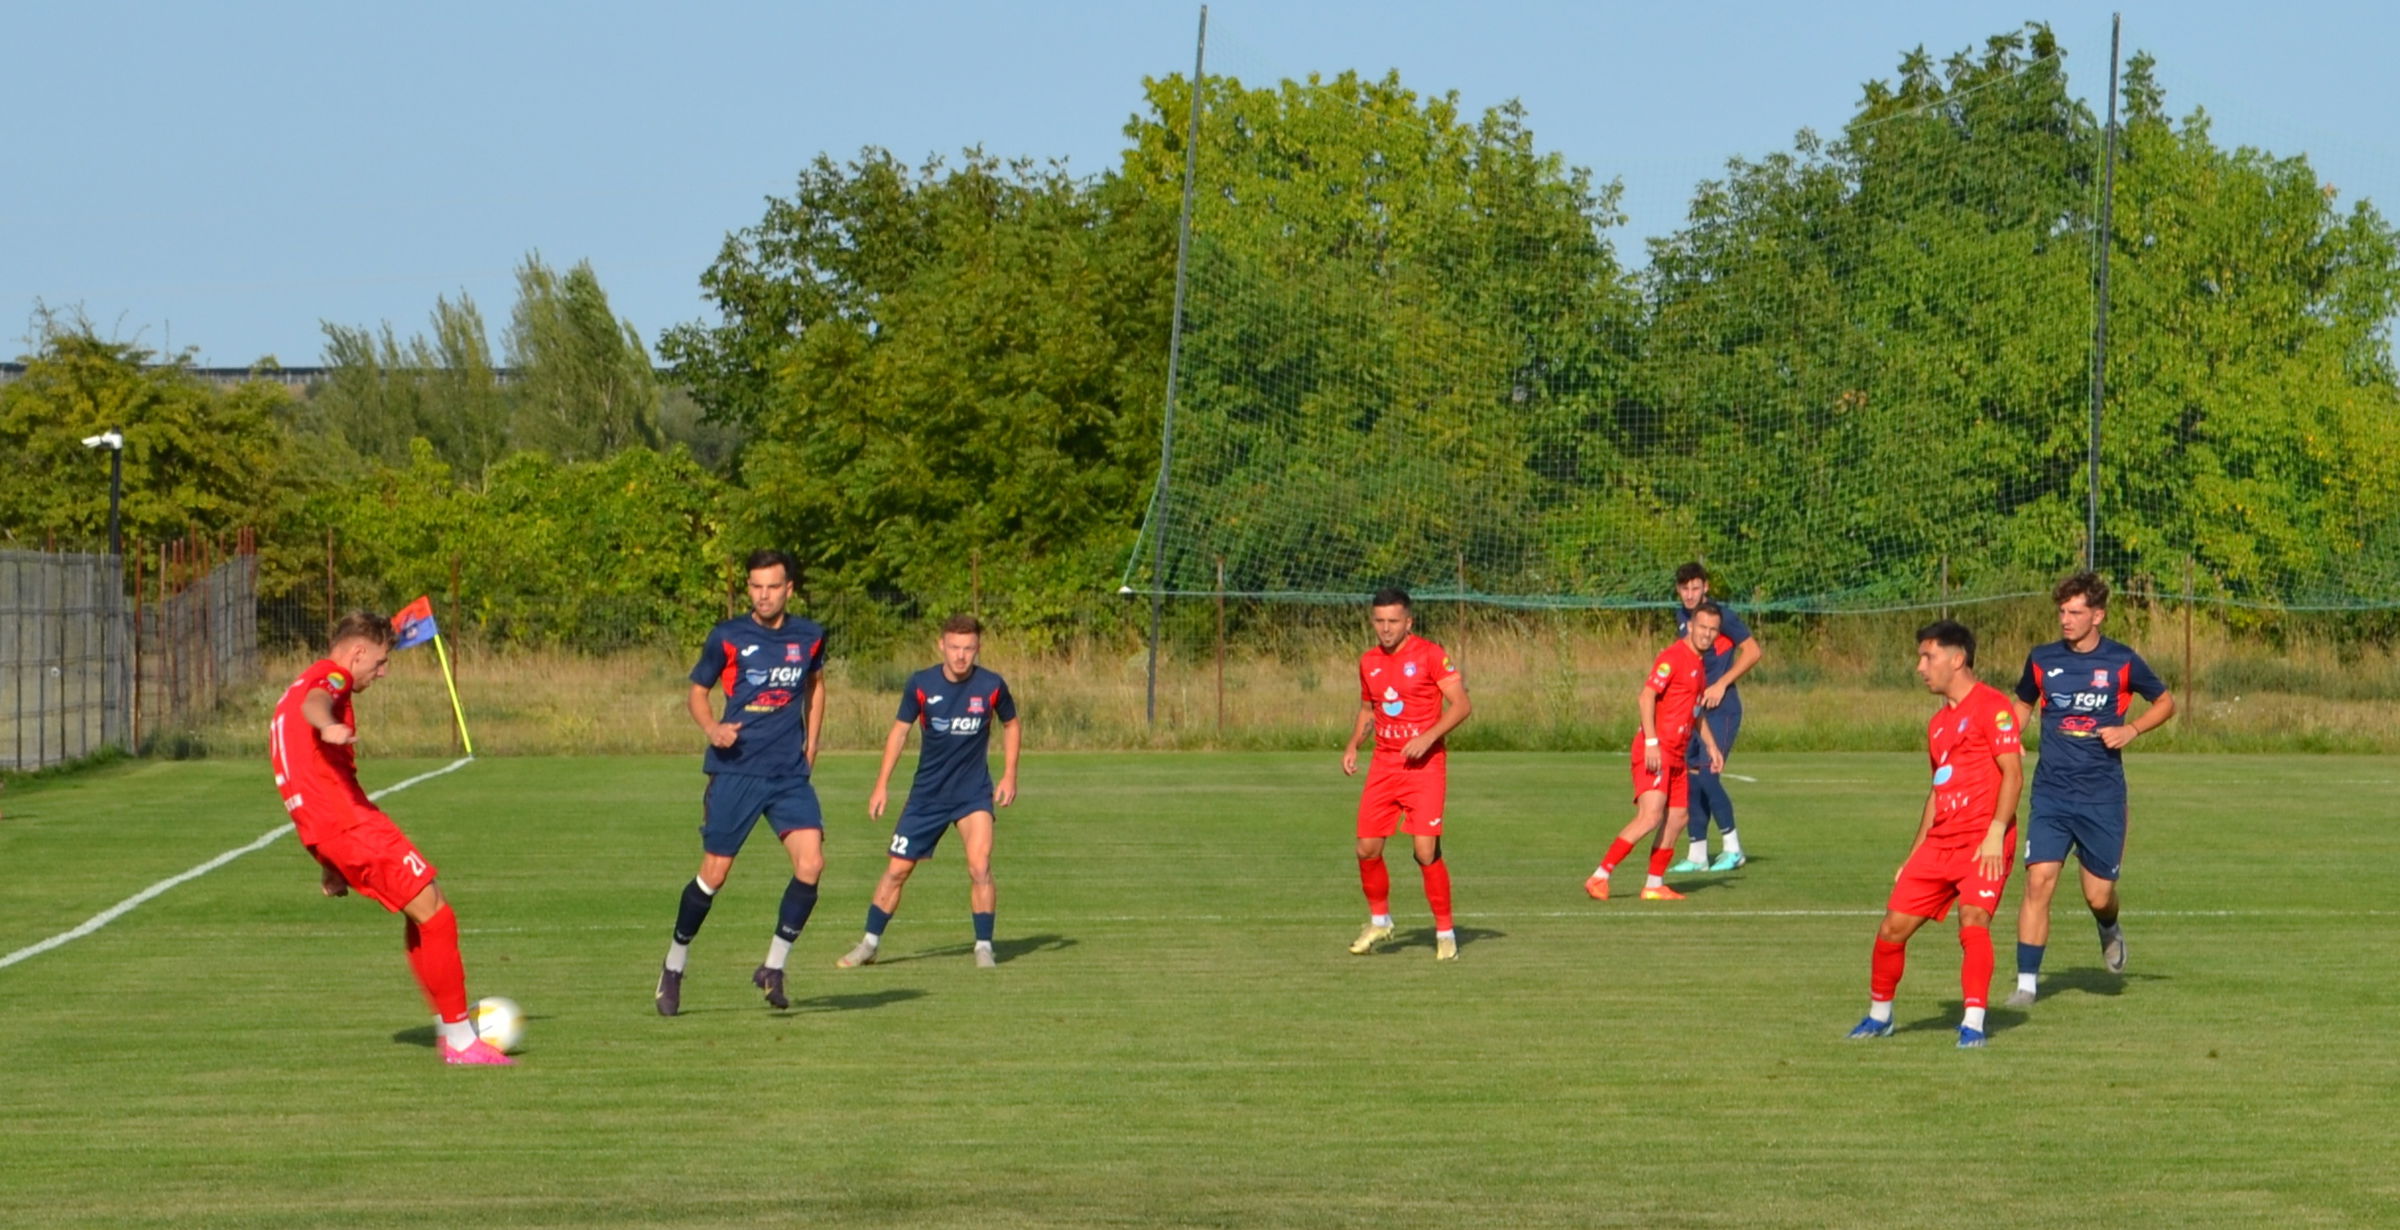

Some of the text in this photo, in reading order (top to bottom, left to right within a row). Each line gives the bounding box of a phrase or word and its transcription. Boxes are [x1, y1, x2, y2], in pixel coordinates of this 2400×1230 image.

[770, 667, 802, 682] FGH
[2075, 692, 2108, 707] FGH
[951, 717, 981, 730] FGH
[890, 834, 909, 855] 22
[403, 850, 426, 877] 21
